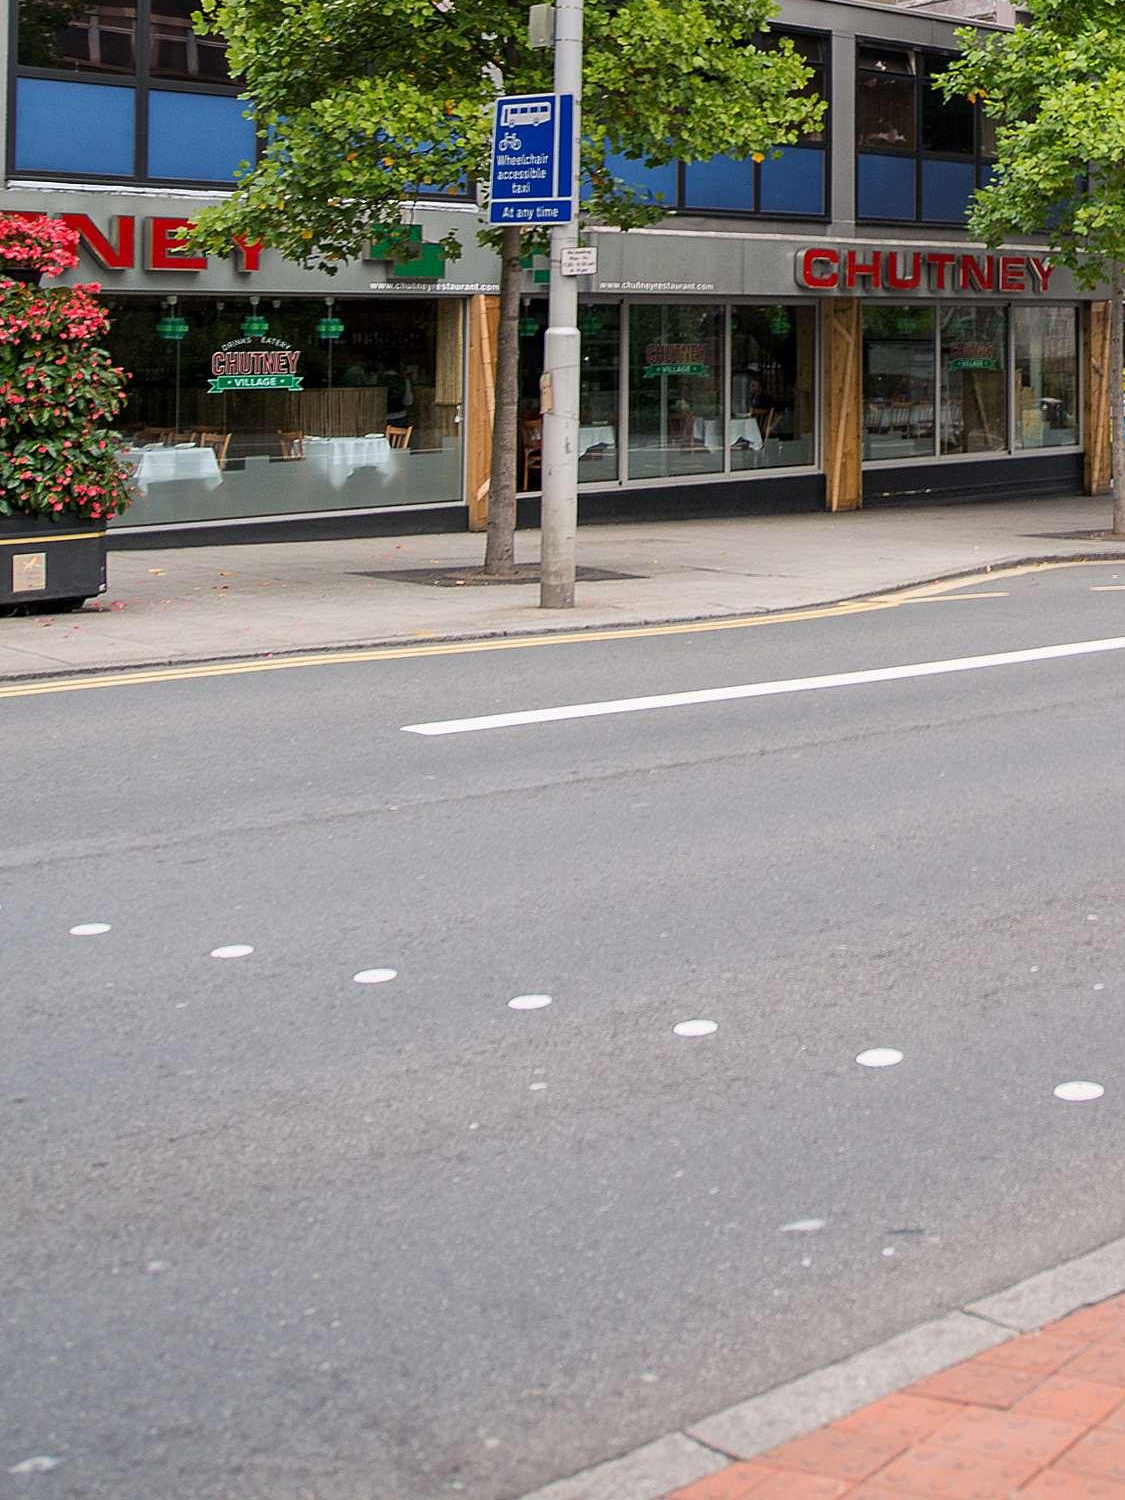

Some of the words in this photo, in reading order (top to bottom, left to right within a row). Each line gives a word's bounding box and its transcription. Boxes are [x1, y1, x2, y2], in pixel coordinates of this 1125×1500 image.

[497, 153, 549, 166] Wheelchair
[497, 168, 547, 180] accessible
[511, 182, 531, 194] taxi
[502, 207, 514, 218] At
[516, 209, 535, 220] any
[536, 206, 559, 218] time
[801, 247, 1055, 293] CHUTNEY
[211, 350, 301, 376] CHUTNEY
[233, 377, 277, 387] VILLAGE
